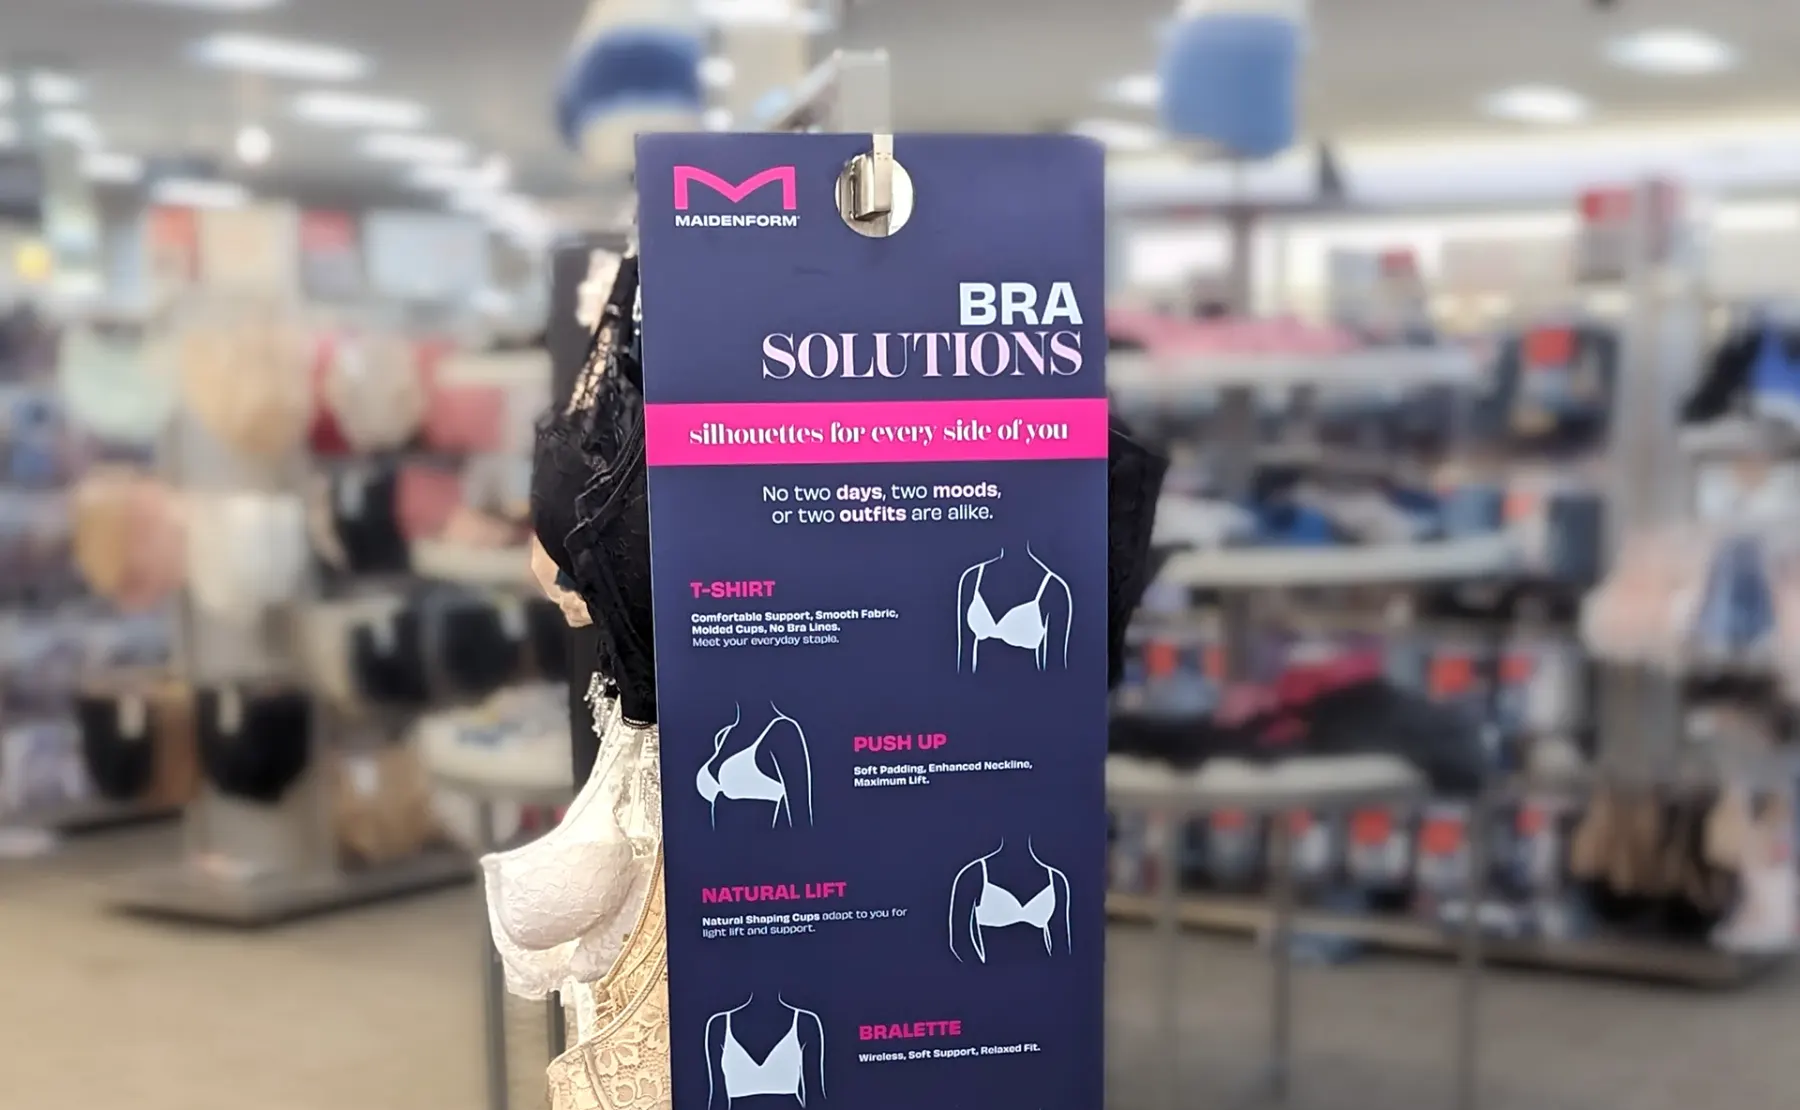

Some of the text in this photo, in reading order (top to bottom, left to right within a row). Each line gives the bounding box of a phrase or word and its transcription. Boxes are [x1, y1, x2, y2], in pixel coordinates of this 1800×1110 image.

[959, 281, 1084, 326] BRA
[761, 330, 1083, 380] SOLUTIONS
[689, 419, 1068, 446] silhouettes for every side of you
[762, 481, 1002, 505] No two days, two moods,
[771, 504, 993, 524] or two outfits are alike.
[690, 581, 776, 599] T-SHIRT
[691, 608, 899, 623] Comfortable Support, Smooth Fabric,
[691, 622, 840, 635] Molded Cups, No Bra Lines.
[692, 633, 840, 648] Meet your everyday staple.
[854, 733, 948, 753] PUSH UP
[853, 760, 1032, 776] Soft Padding, Enhanced Neckline,
[854, 776, 930, 787] Maximum Lift.
[701, 881, 847, 904] NATURAL LIFT
[702, 908, 908, 927] Natural Shaping Cups adapt to you for
[702, 923, 816, 939] light lift and support.
[859, 1020, 962, 1041] BRALETTE
[859, 1043, 1041, 1063] Wireless, Soft Support, Relaxed Fit.
